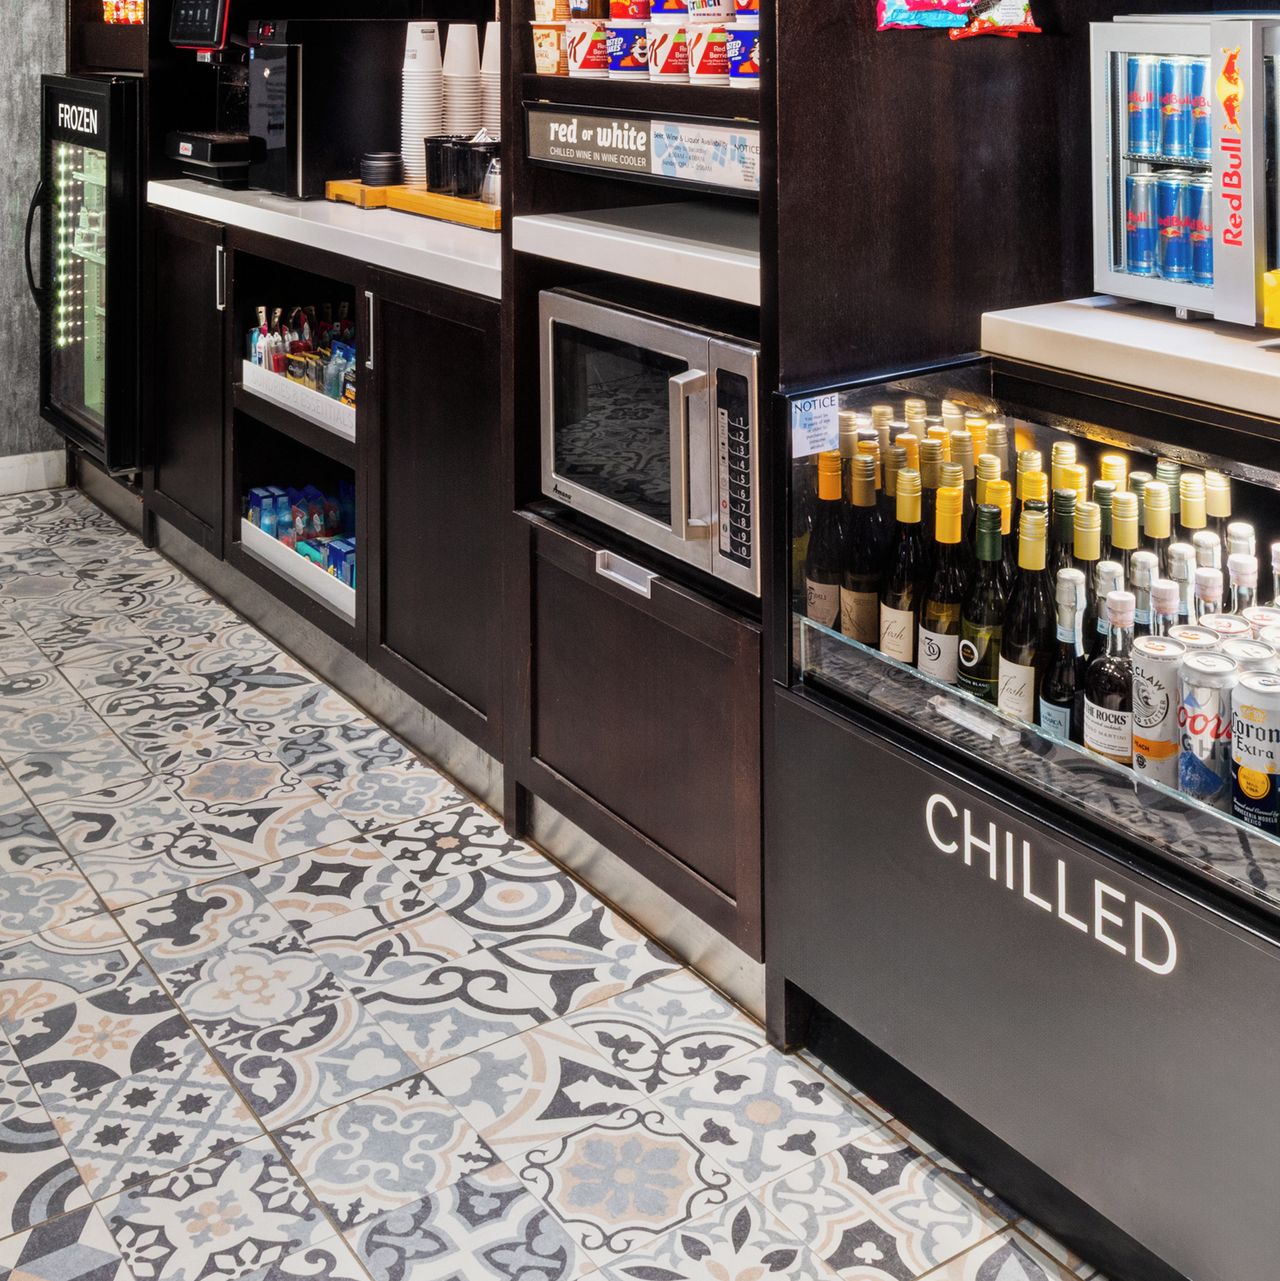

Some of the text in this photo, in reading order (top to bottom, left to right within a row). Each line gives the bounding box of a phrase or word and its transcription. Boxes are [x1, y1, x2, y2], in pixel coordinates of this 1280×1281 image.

[57, 103, 98, 135] FROZEN
[549, 118, 647, 151] red or white
[666, 132, 679, 142] Wine
[549, 146, 647, 167] CHILLED WINE IN WINE COOLER
[734, 143, 760, 155] NOTICE
[1220, 137, 1243, 247] Red Bull
[300, 391, 355, 431] ESSENTIALS
[794, 396, 836, 414] NOTICE
[1134, 666, 1166, 692] CLAW
[1085, 703, 1127, 725] THE ROCKS
[1143, 699, 1168, 726] SELTZER
[1102, 731, 1127, 742] MARTINI
[1235, 734, 1275, 761] Extra
[925, 793, 1178, 976] CHILLED
